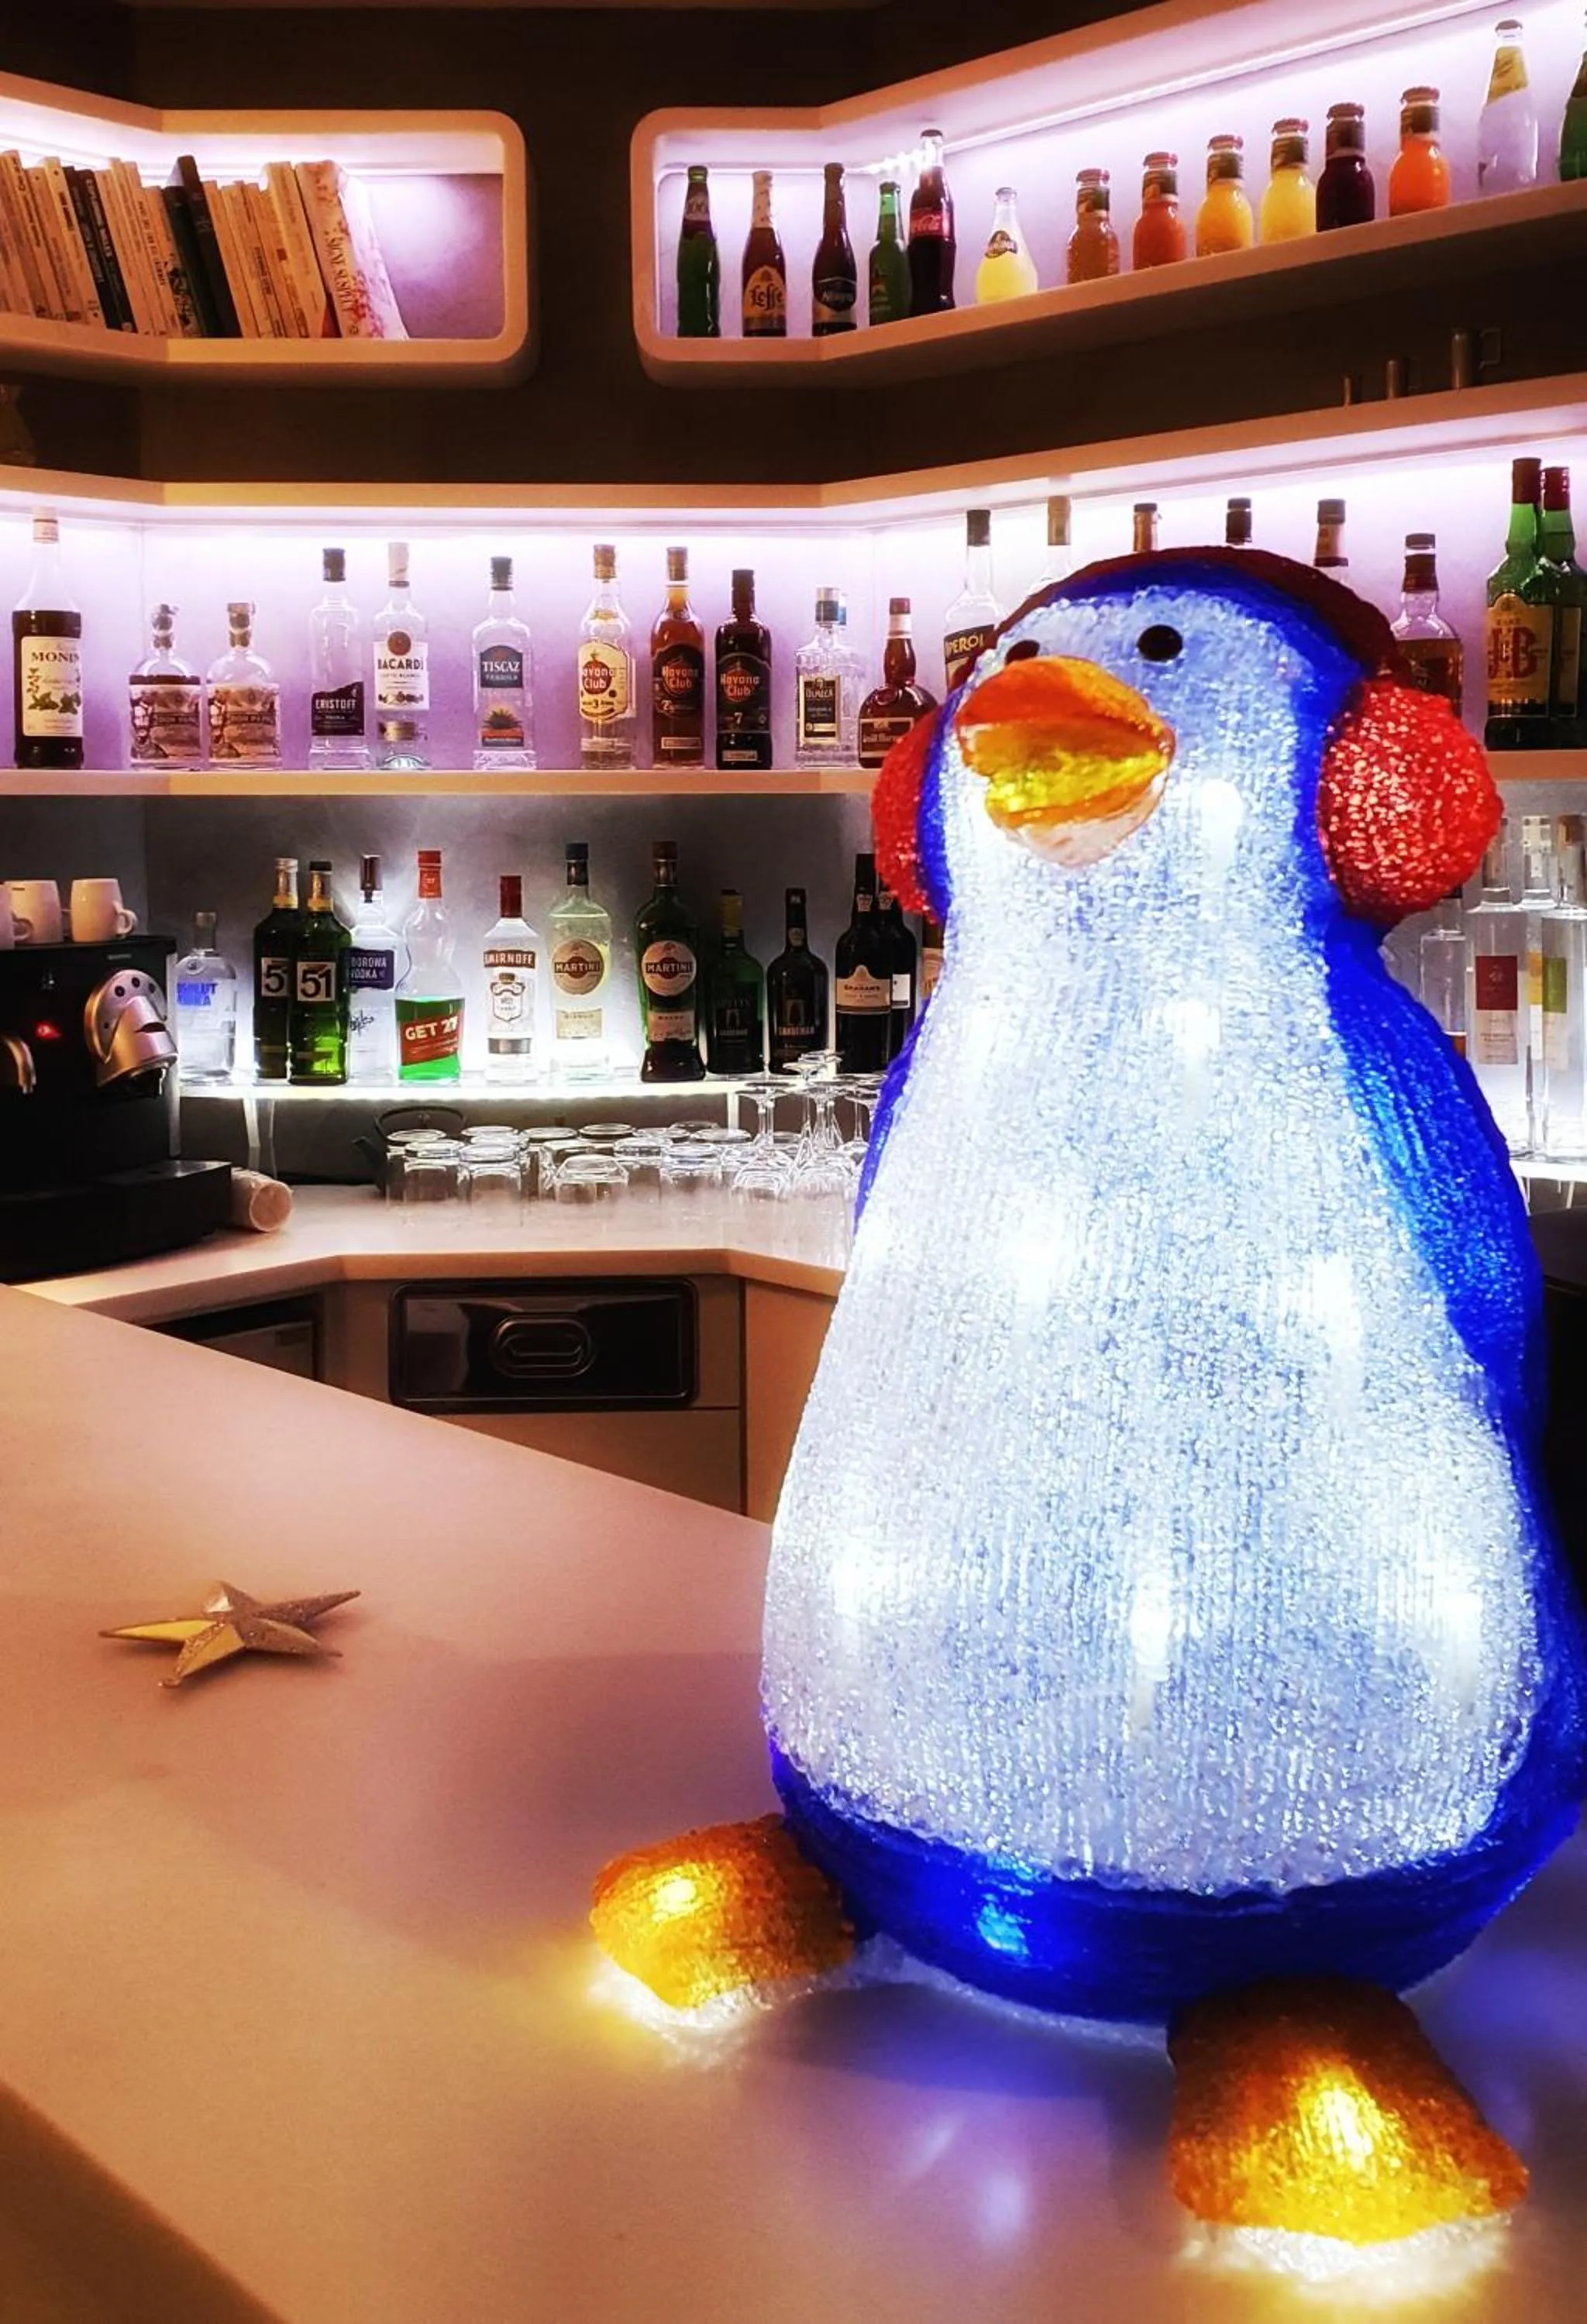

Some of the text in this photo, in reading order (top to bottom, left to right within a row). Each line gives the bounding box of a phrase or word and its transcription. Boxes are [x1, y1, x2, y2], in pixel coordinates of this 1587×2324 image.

[749, 283, 784, 311] Leffe
[377, 658, 424, 670] BACARDI
[483, 661, 520, 673] TISCAZ
[582, 669, 614, 677] avana
[720, 672, 760, 685] Havana
[584, 677, 607, 689] Club
[669, 677, 692, 689] Club
[727, 685, 751, 696] Club
[315, 699, 356, 710] ERISTOFF
[593, 700, 599, 708] 3
[734, 712, 742, 724] 7
[484, 953, 533, 965] SMIRNOFF
[556, 962, 599, 972] MARTINI
[646, 963, 694, 973] MARTINI
[264, 964, 288, 993] 5
[301, 968, 332, 999] 51
[405, 1016, 458, 1041] GET 27
